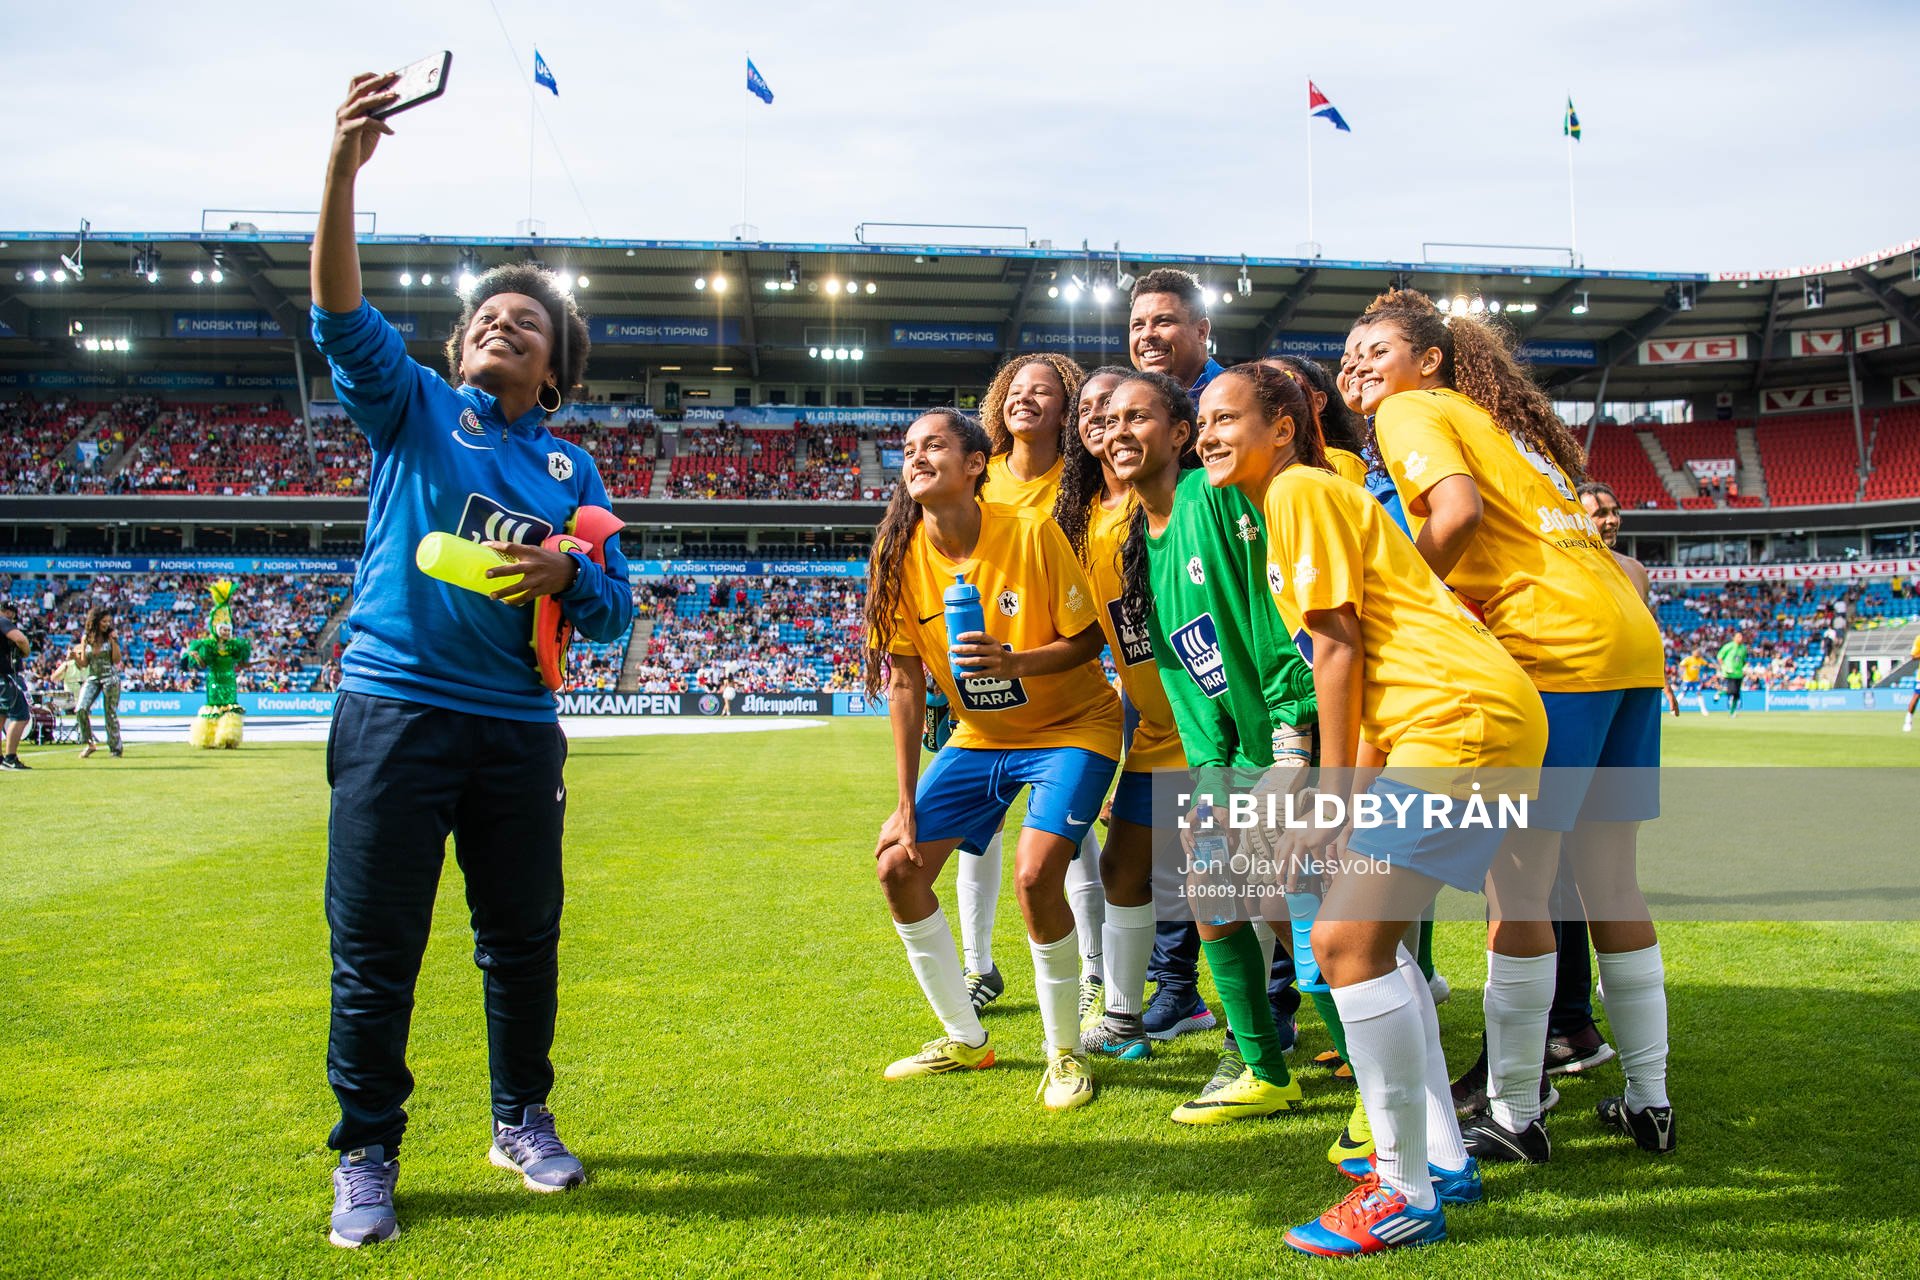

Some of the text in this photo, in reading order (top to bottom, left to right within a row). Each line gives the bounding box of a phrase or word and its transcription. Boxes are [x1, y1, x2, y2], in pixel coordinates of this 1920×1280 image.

[191, 320, 233, 331] NORSK
[620, 326, 709, 337] NORSK TIPPING
[908, 331, 994, 343] NORSK TIPPING
[1036, 333, 1120, 346] NORSK TIPPING
[1806, 325, 1887, 351] VG
[1283, 341, 1344, 351] NORSK TIPP
[1650, 340, 1735, 361] VG
[1554, 349, 1594, 359] TIPPING
[40, 375, 116, 385] NORSK TIPPING
[139, 376, 215, 386] NORSK TIPPING
[238, 377, 299, 386] NORSK TIPP
[1768, 386, 1852, 410] VG
[805, 411, 816, 420] VI
[817, 411, 834, 421] GIR
[837, 412, 889, 422] DRØMMEN
[891, 412, 905, 422] EN
[555, 458, 569, 471] K
[1692, 461, 1731, 472] VG
[0, 560, 29, 569] PPING
[57, 560, 132, 570] NORSK TIPPING
[160, 561, 235, 570] NORSK TIPPING
[263, 561, 338, 571] NORSK TIPPING
[673, 563, 747, 573] NORSK TIPPING
[774, 564, 847, 574] NORSK TIPPING
[1850, 562, 1897, 575] VG
[1687, 569, 1730, 580] VG
[1740, 567, 1784, 579] VG
[1794, 566, 1840, 577] VG
[1003, 598, 1015, 610] K
[1126, 640, 1153, 659] YAR
[968, 691, 1018, 706] YARA
[140, 699, 181, 712] grows
[257, 698, 333, 713] Knowledge
[927, 708, 935, 749] POWERADE
